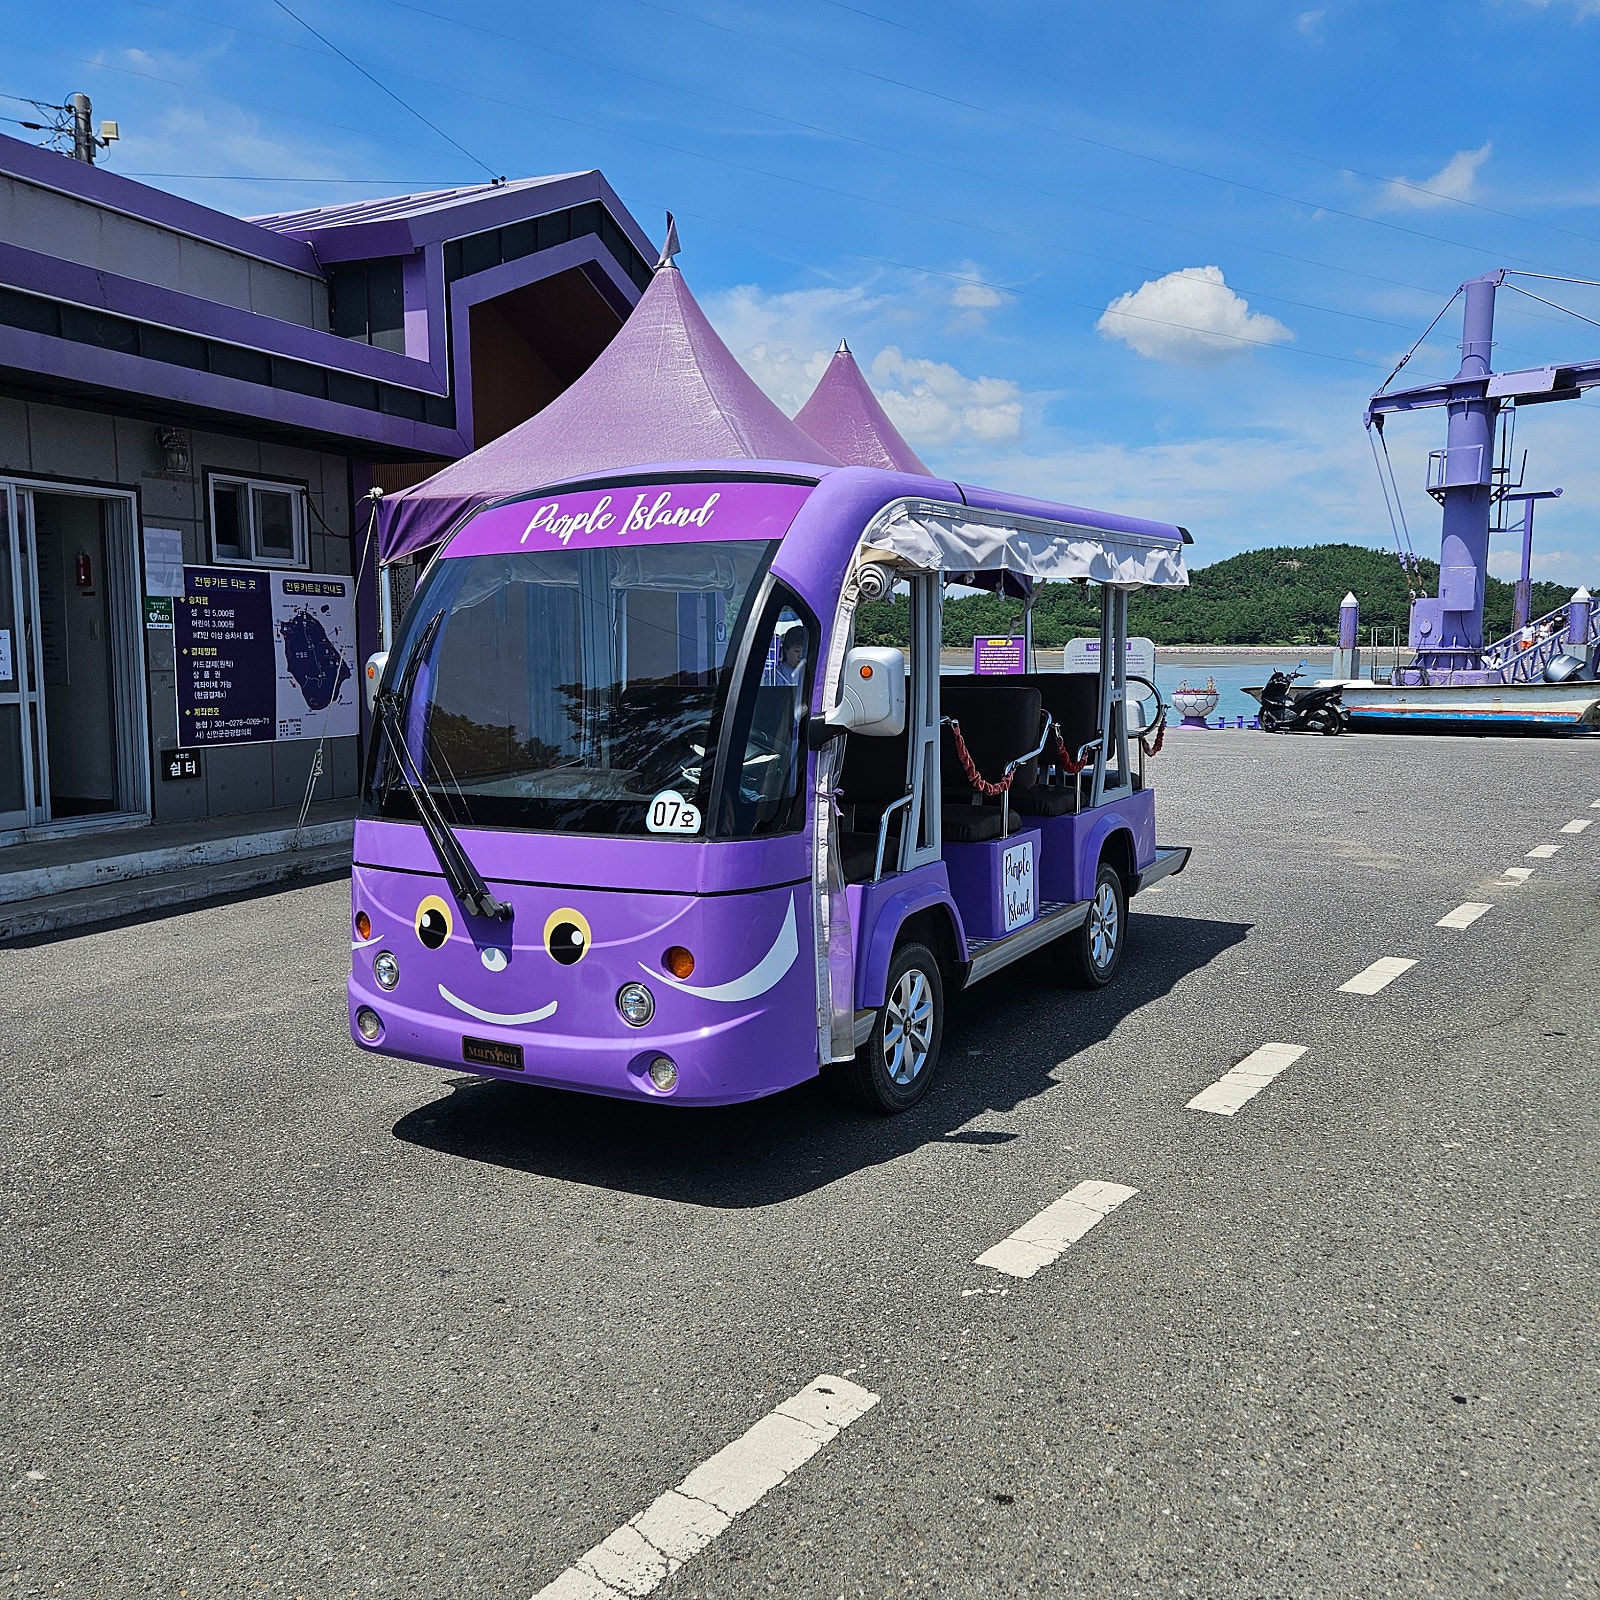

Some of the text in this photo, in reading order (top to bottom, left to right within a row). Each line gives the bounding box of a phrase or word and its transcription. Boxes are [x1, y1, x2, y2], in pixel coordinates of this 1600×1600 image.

[519, 491, 721, 546] Purple Island
[194, 576, 256, 590] 전동카트 타는 곳
[285, 582, 343, 594] 전동카트길 안내도
[188, 596, 209, 605] 승차료
[212, 609, 235, 618] 5,000원
[191, 619, 235, 629] 어린이 3,000원
[210, 631, 223, 640] 이상
[219, 680, 233, 689] 가능
[653, 801, 695, 828] 07호
[1005, 846, 1031, 887] Purple
[1006, 888, 1031, 926] Island
